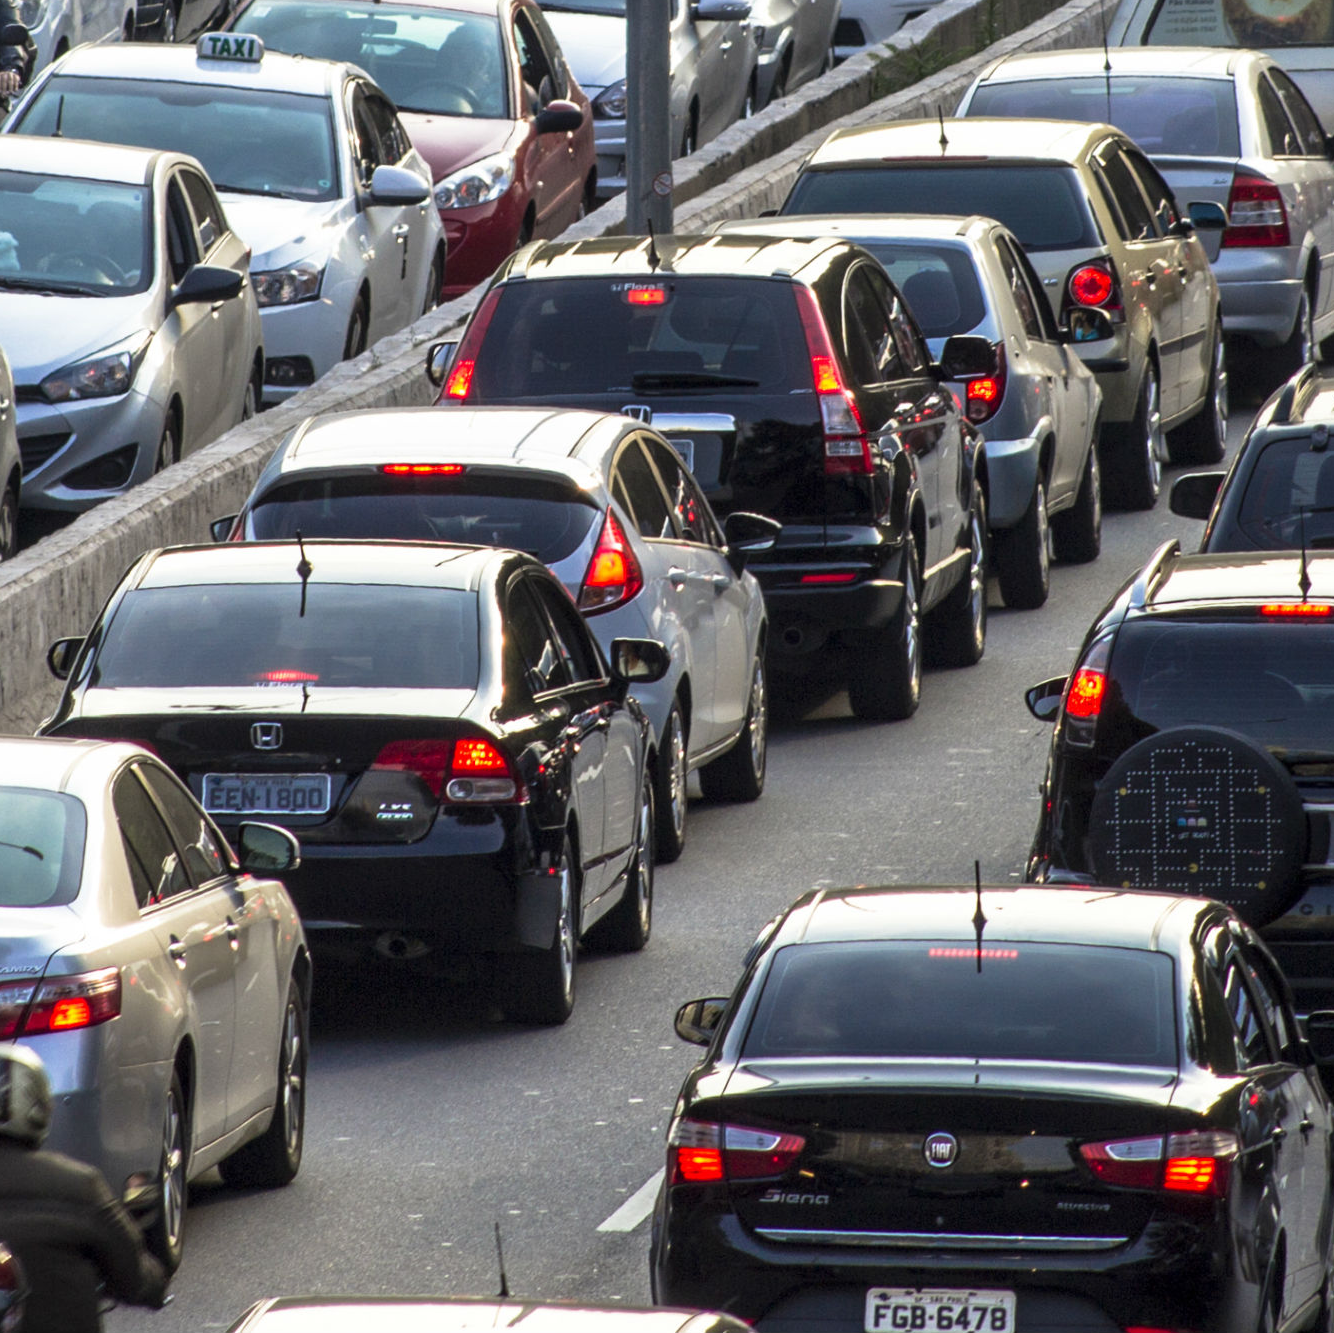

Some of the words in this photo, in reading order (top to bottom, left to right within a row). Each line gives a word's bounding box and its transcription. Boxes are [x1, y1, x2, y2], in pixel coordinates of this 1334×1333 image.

[208, 36, 255, 58] TAXI
[932, 1142, 952, 1158] FIAT
[759, 1189, 830, 1204] Siena
[873, 1304, 1007, 1332] FGB-6478
